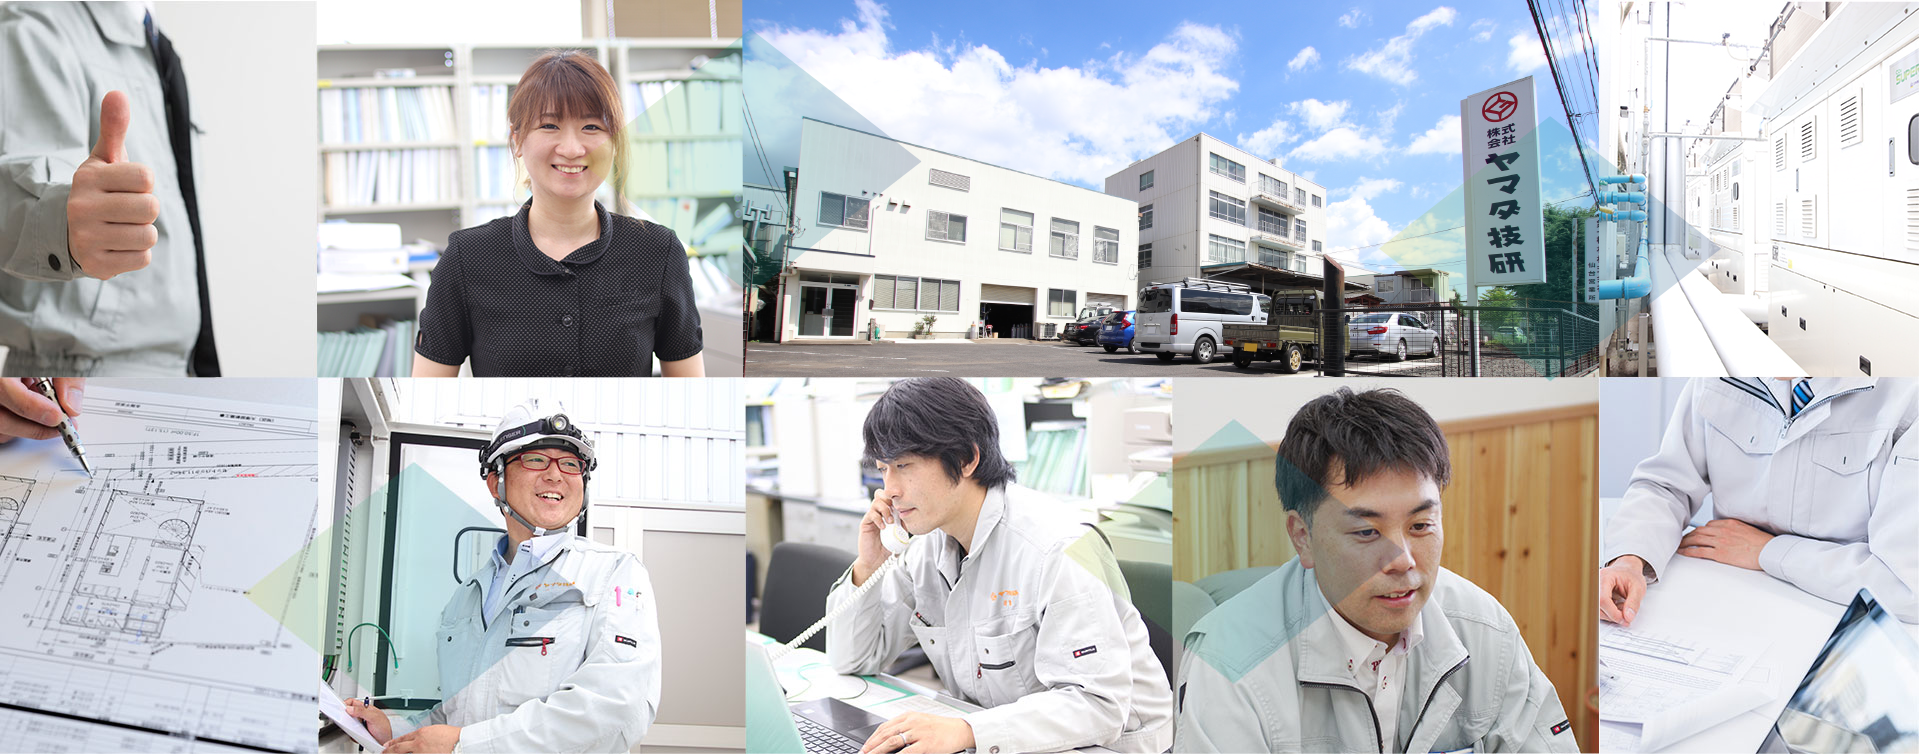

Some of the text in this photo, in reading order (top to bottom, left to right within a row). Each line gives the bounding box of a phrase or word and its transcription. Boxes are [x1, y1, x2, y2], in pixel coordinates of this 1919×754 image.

[1484, 151, 1526, 275] ヤマダ技研
